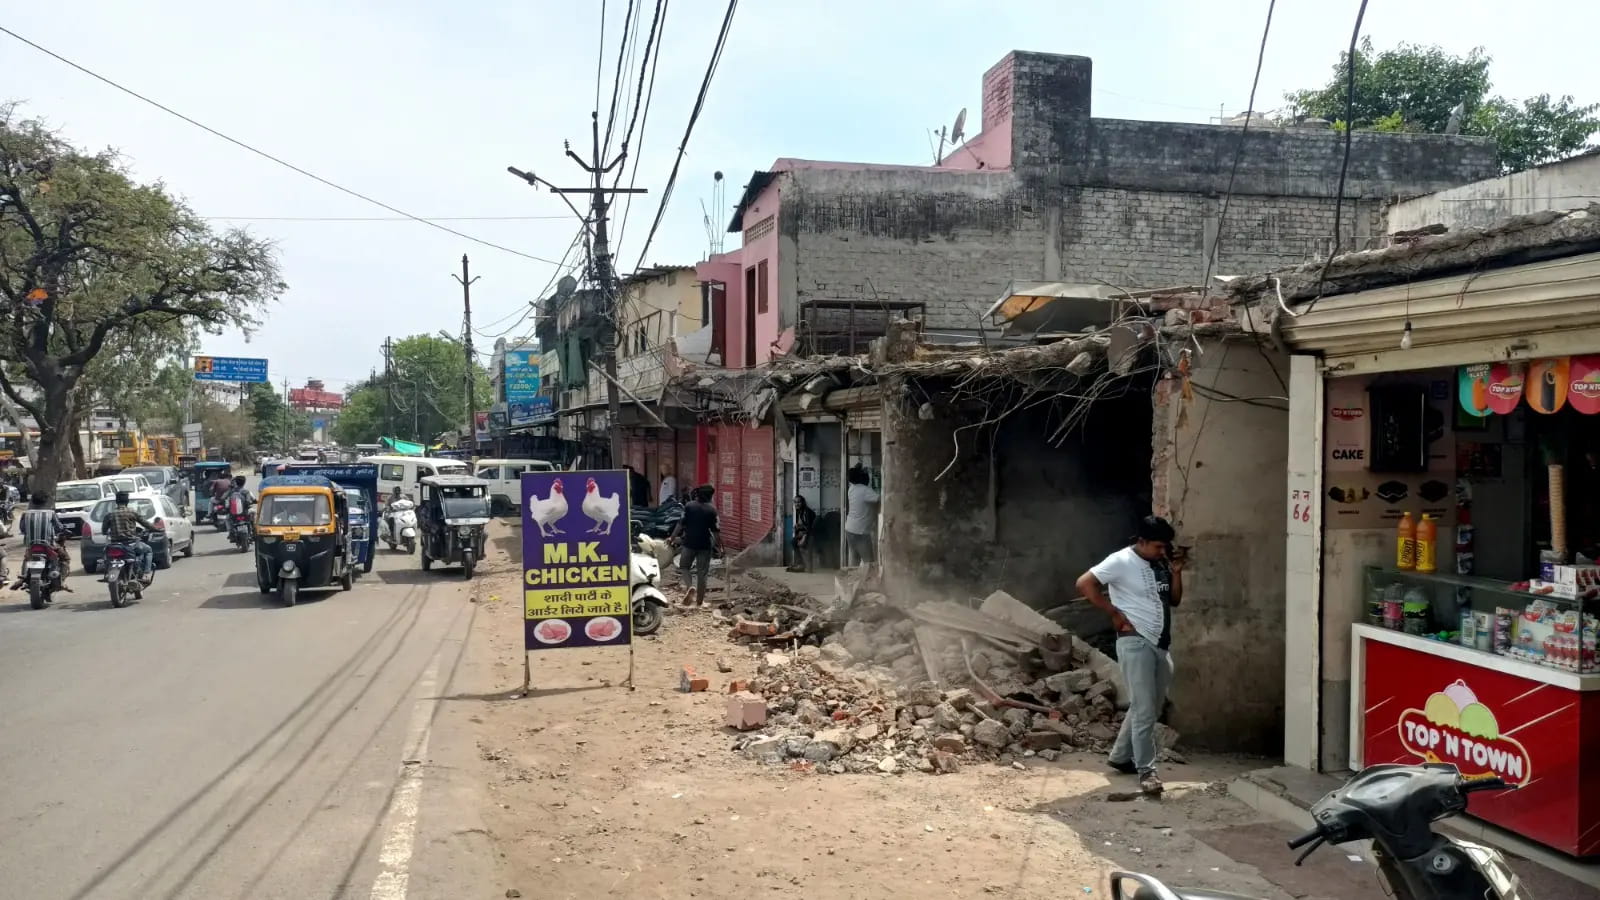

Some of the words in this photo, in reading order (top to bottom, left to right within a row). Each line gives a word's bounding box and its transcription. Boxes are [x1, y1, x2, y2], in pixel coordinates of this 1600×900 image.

[1574, 383, 1588, 391] TOP
[1332, 449, 1363, 460] CAKE
[1293, 503, 1310, 522] 66
[543, 541, 609, 564] M.K.
[525, 565, 628, 585] CHICKEN
[543, 591, 572, 603] शादी
[600, 590, 612, 600] के
[560, 603, 584, 615] लिये
[587, 602, 611, 614] जाते
[1405, 720, 1440, 749] TOP
[1461, 738, 1523, 779] TOWN
